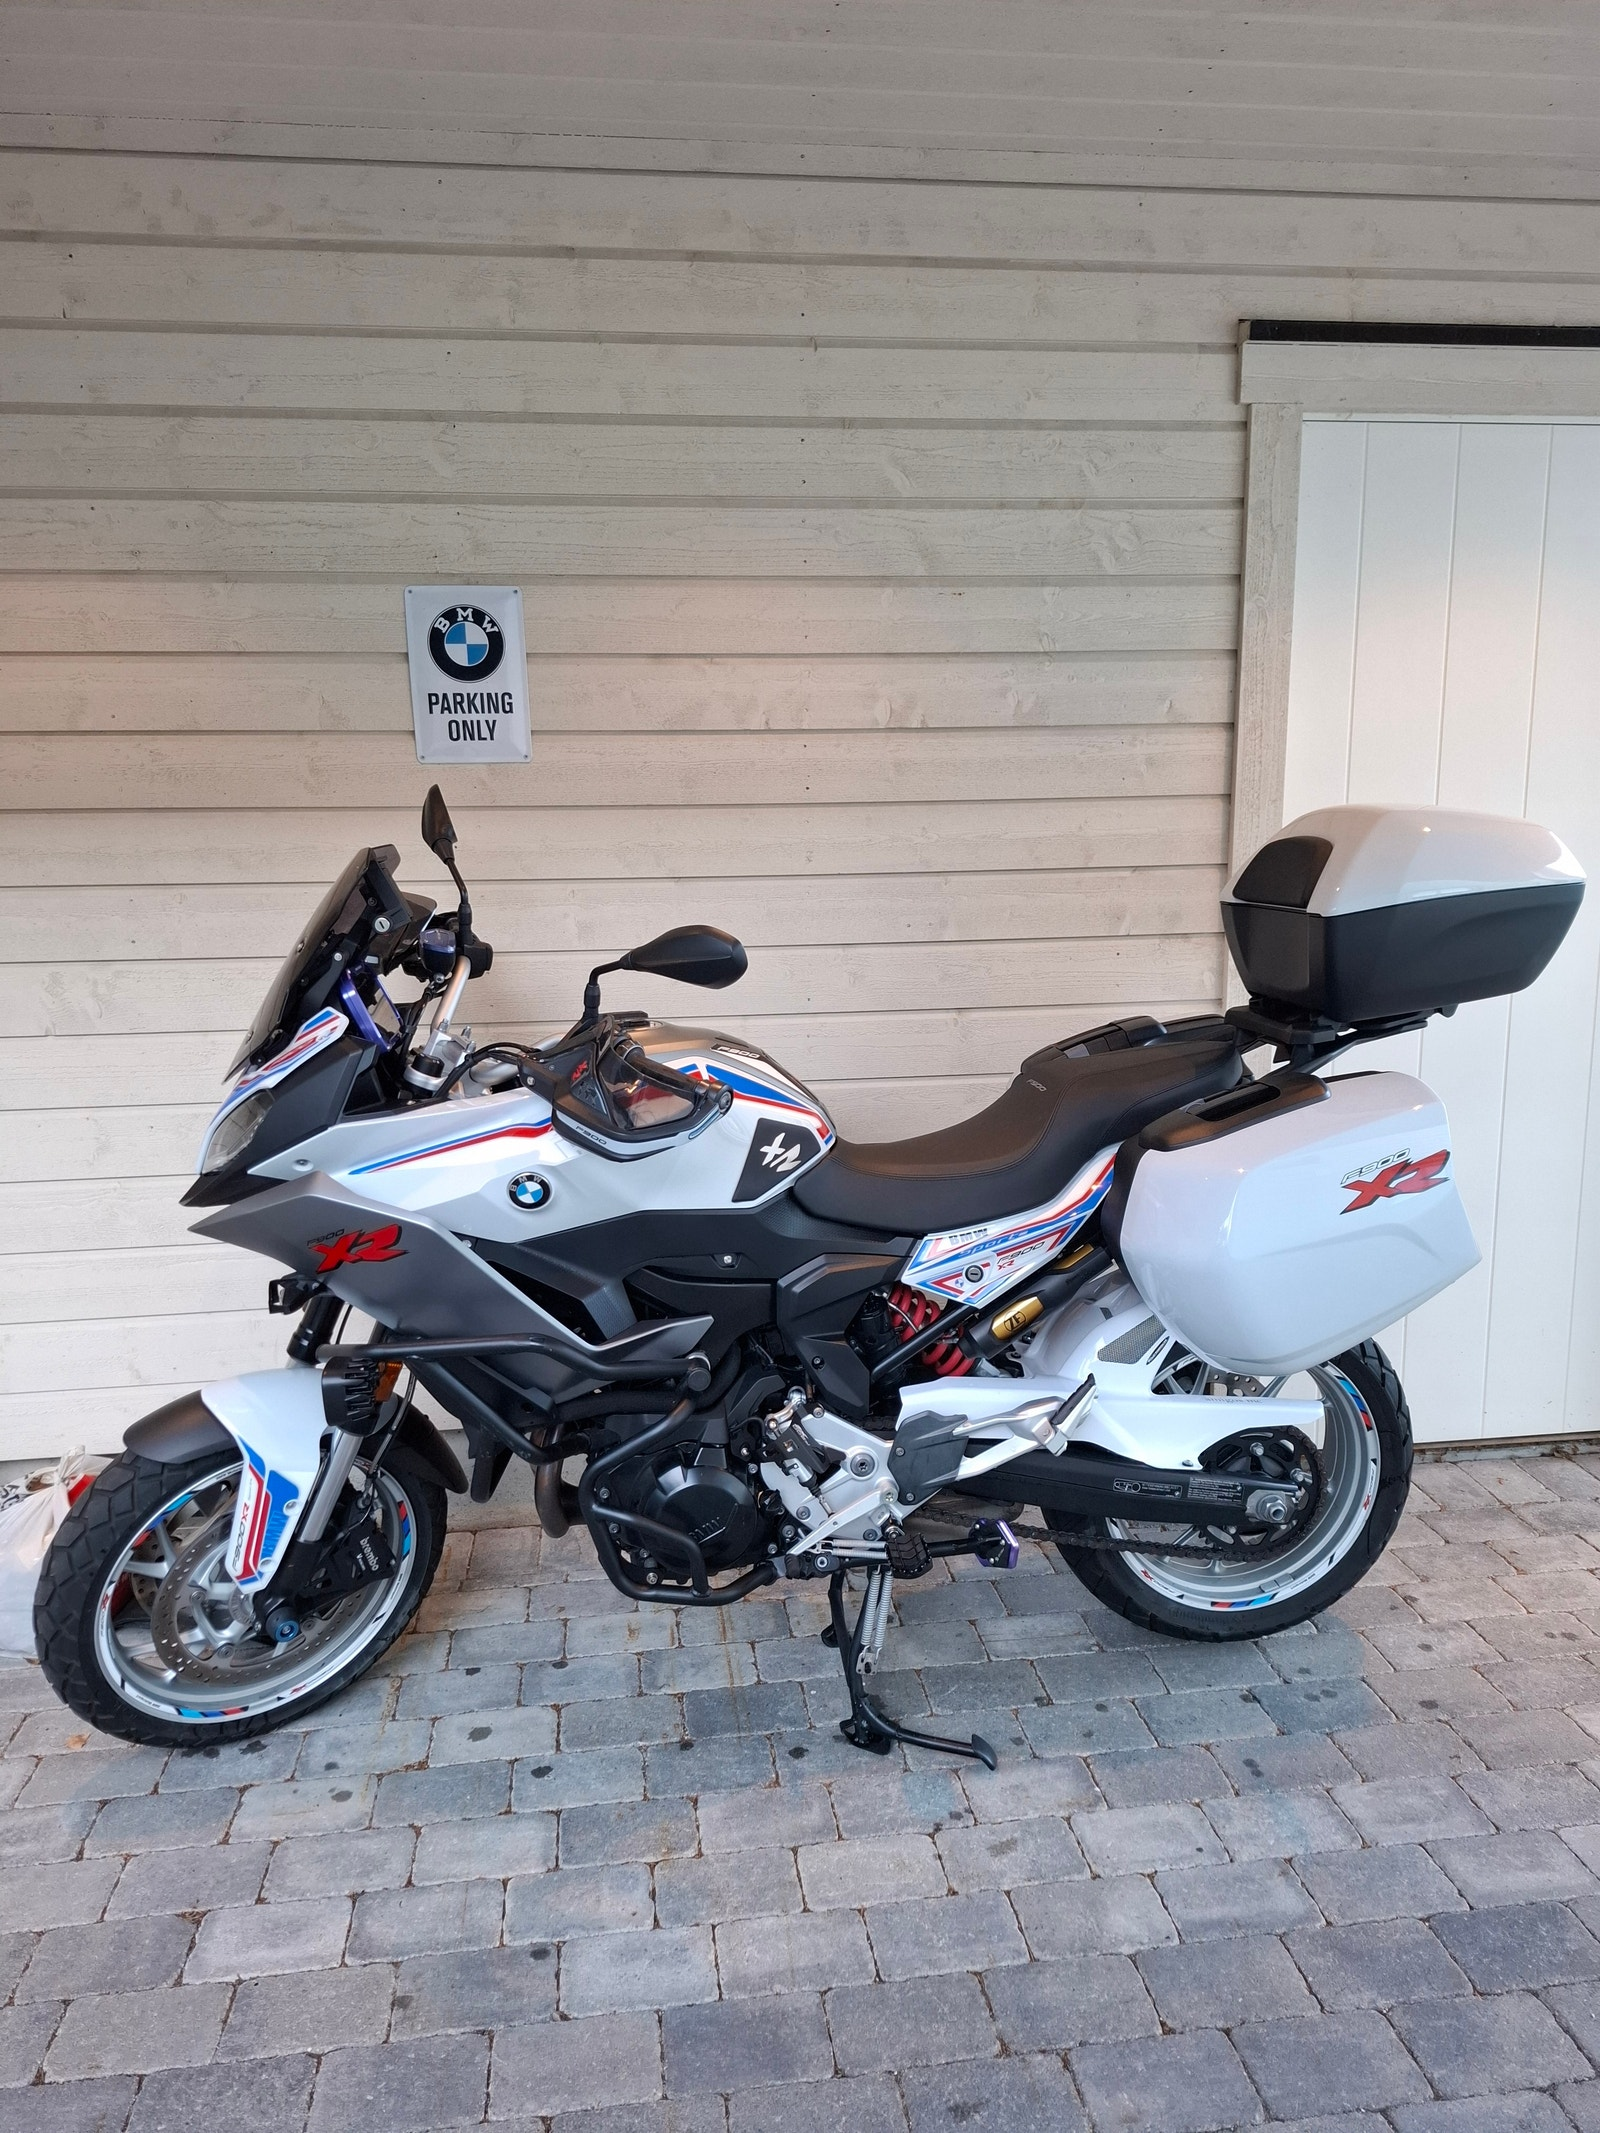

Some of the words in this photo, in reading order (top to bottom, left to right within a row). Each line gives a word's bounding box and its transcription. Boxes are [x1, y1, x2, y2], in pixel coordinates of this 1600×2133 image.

[434, 607, 499, 634] BMW
[427, 692, 514, 715] PARKING
[448, 719, 497, 741] ONLY
[717, 1046, 760, 1059] F900
[576, 1125, 607, 1146] F900
[1340, 1148, 1411, 1185] F900
[510, 1175, 543, 1192] BMW
[306, 1228, 345, 1247] F900
[997, 1241, 1045, 1265] F900
[1004, 1311, 1026, 1332] ZF
[360, 1536, 379, 1572] brembo
